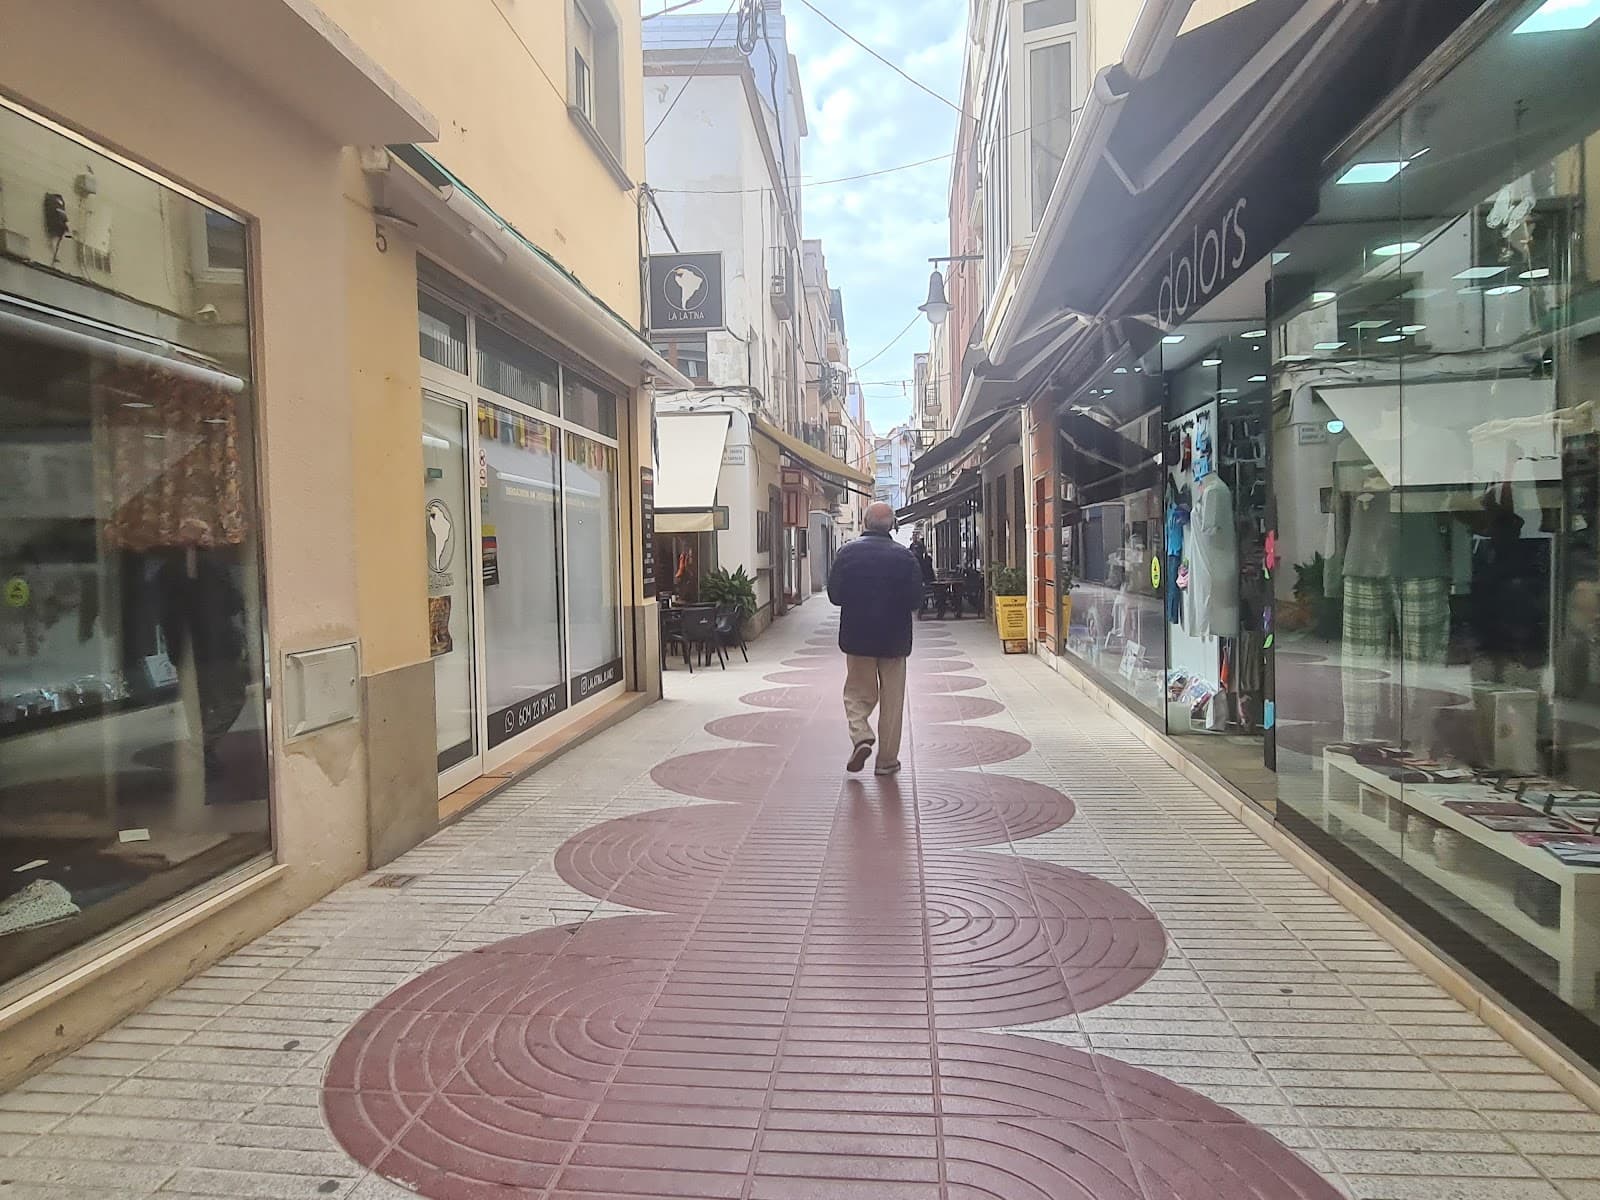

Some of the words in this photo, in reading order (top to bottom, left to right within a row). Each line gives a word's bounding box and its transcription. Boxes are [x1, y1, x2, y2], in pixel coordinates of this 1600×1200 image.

[375, 223, 388, 253] 5
[1158, 198, 1247, 329] dolors
[668, 311, 678, 320] LA
[679, 311, 705, 320] LATINA
